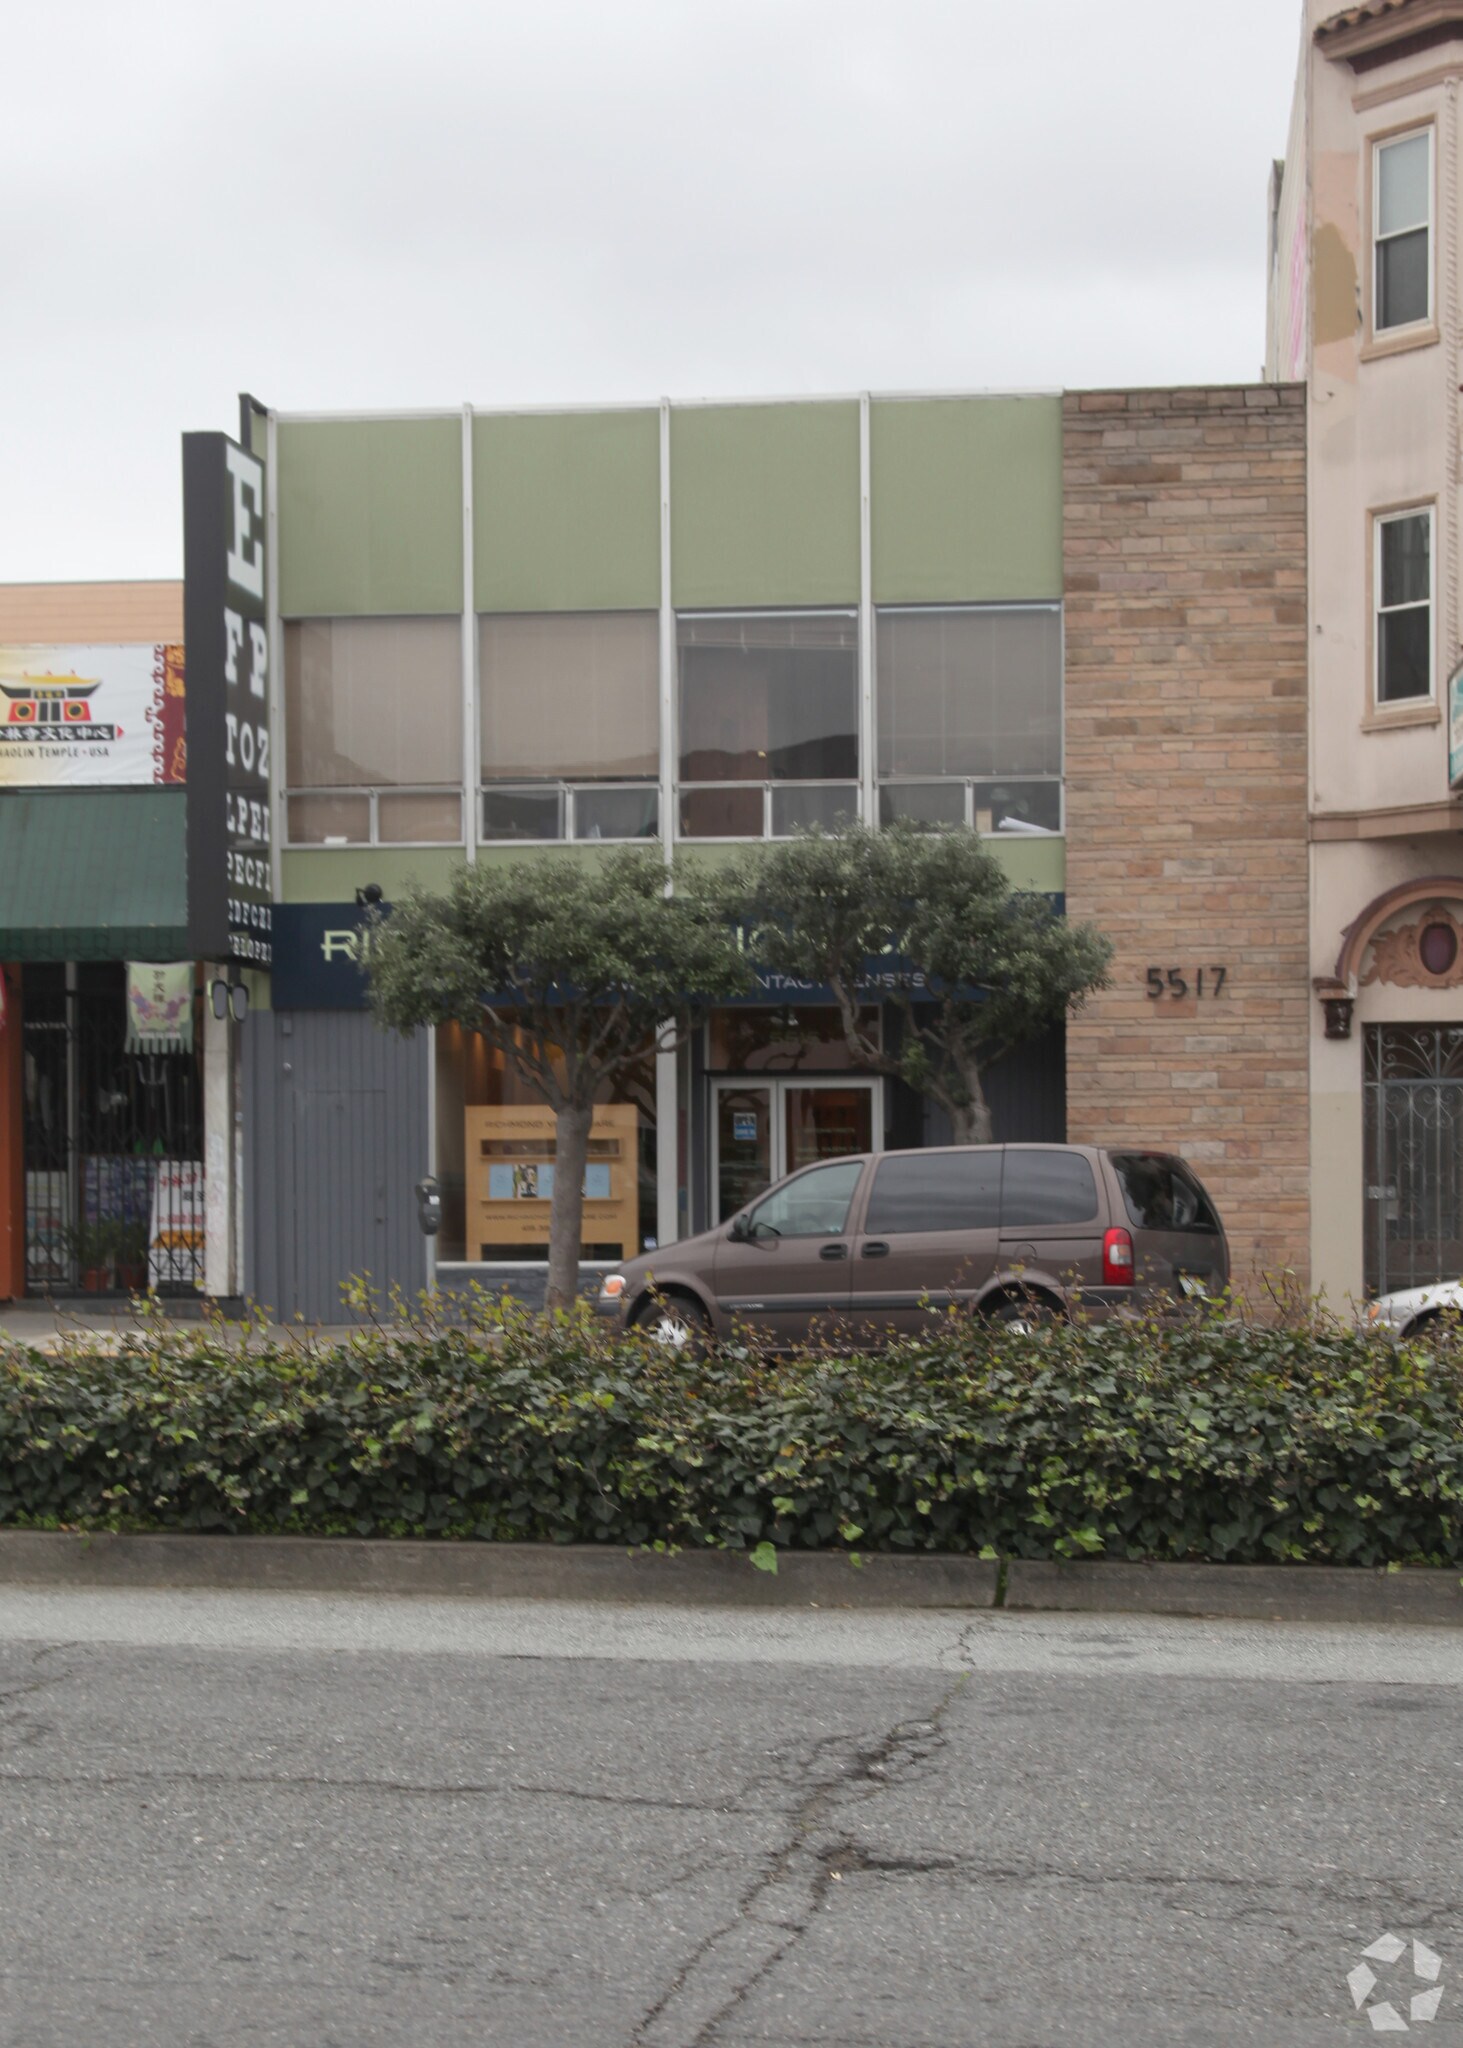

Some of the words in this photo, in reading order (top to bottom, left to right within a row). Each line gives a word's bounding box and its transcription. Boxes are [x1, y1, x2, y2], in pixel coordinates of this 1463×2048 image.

[226, 441, 263, 600] E
[0, 726, 111, 740] 林寺文化中心
[225, 712, 269, 779] TOZ
[88, 746, 109, 757] USA
[1146, 966, 1227, 998] 5517
